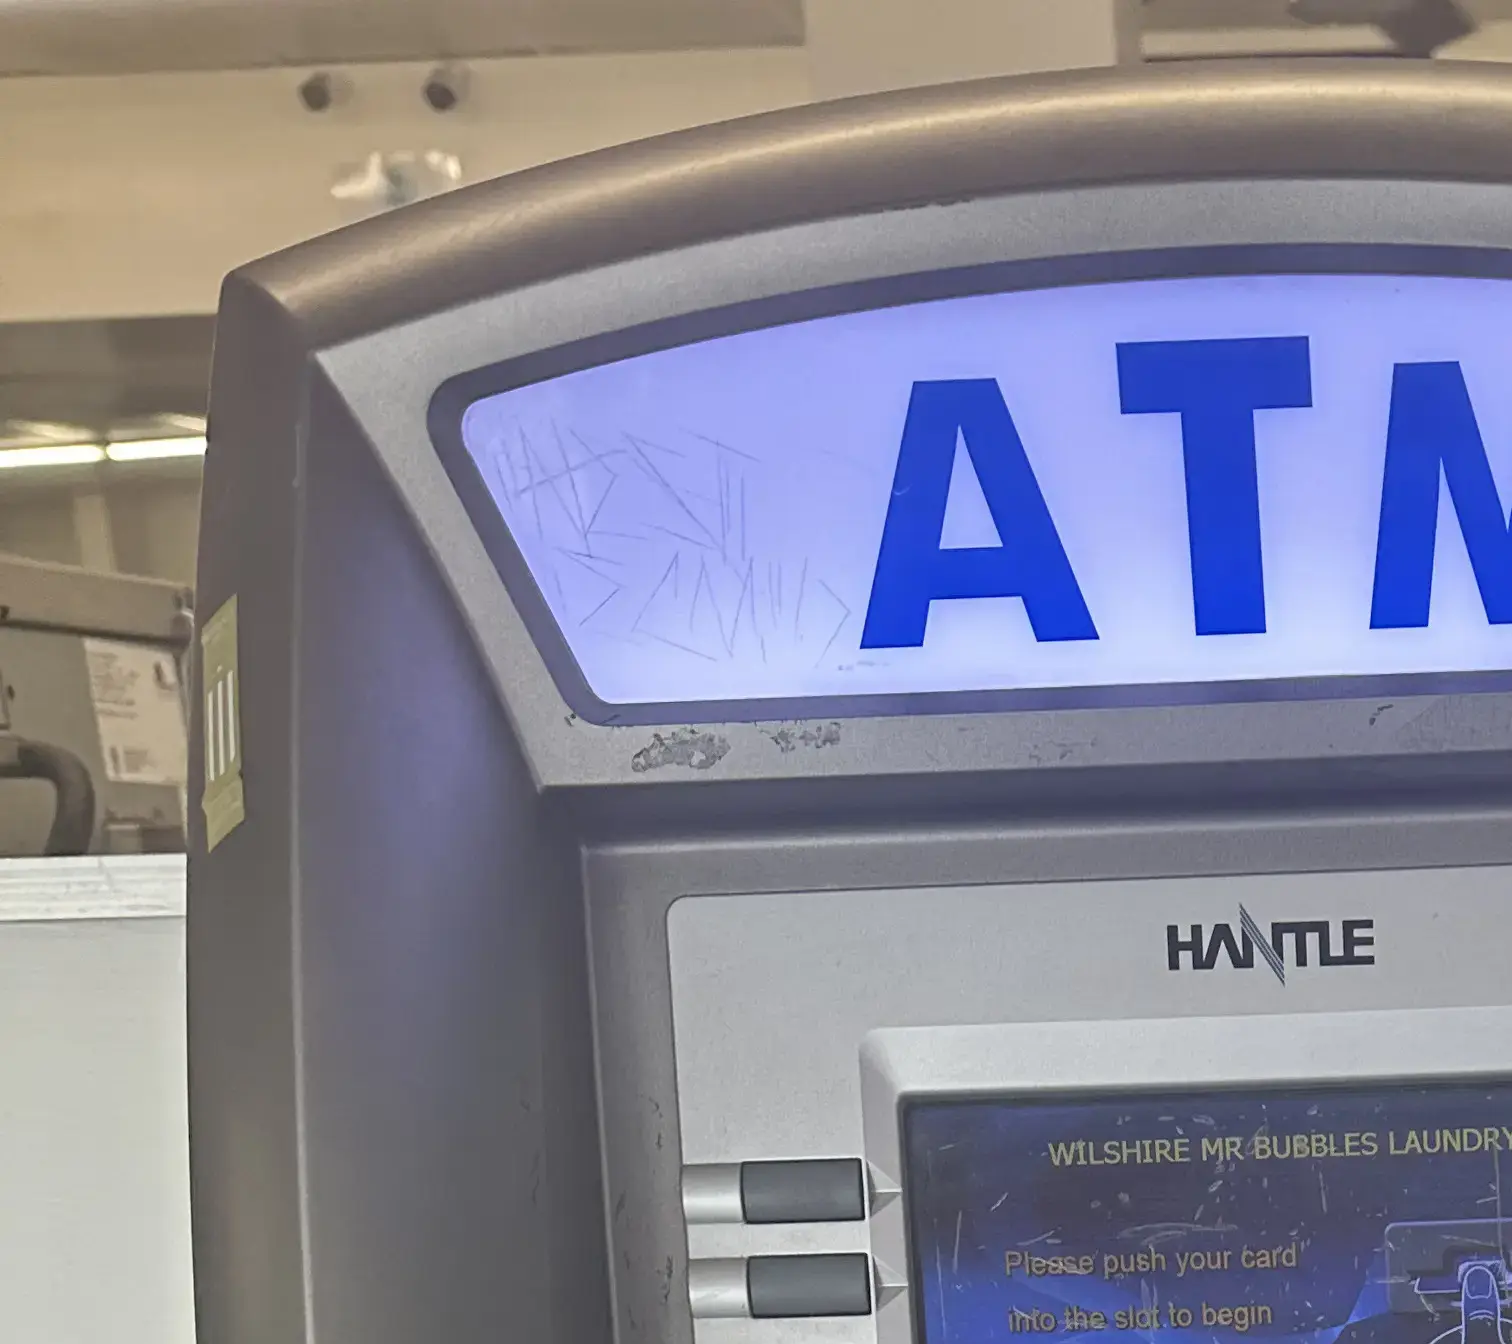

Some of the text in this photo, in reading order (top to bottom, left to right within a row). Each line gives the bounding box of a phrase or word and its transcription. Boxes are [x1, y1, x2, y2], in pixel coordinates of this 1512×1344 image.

[1167, 903, 1375, 987] HANTLE
[1048, 1138, 1191, 1166] WILSHIRE
[1201, 1136, 1244, 1162] MR
[1255, 1132, 1378, 1160] BUBBLES
[1005, 1244, 1298, 1280] Please push your card
[1008, 1301, 1272, 1333] into the slot to begin
